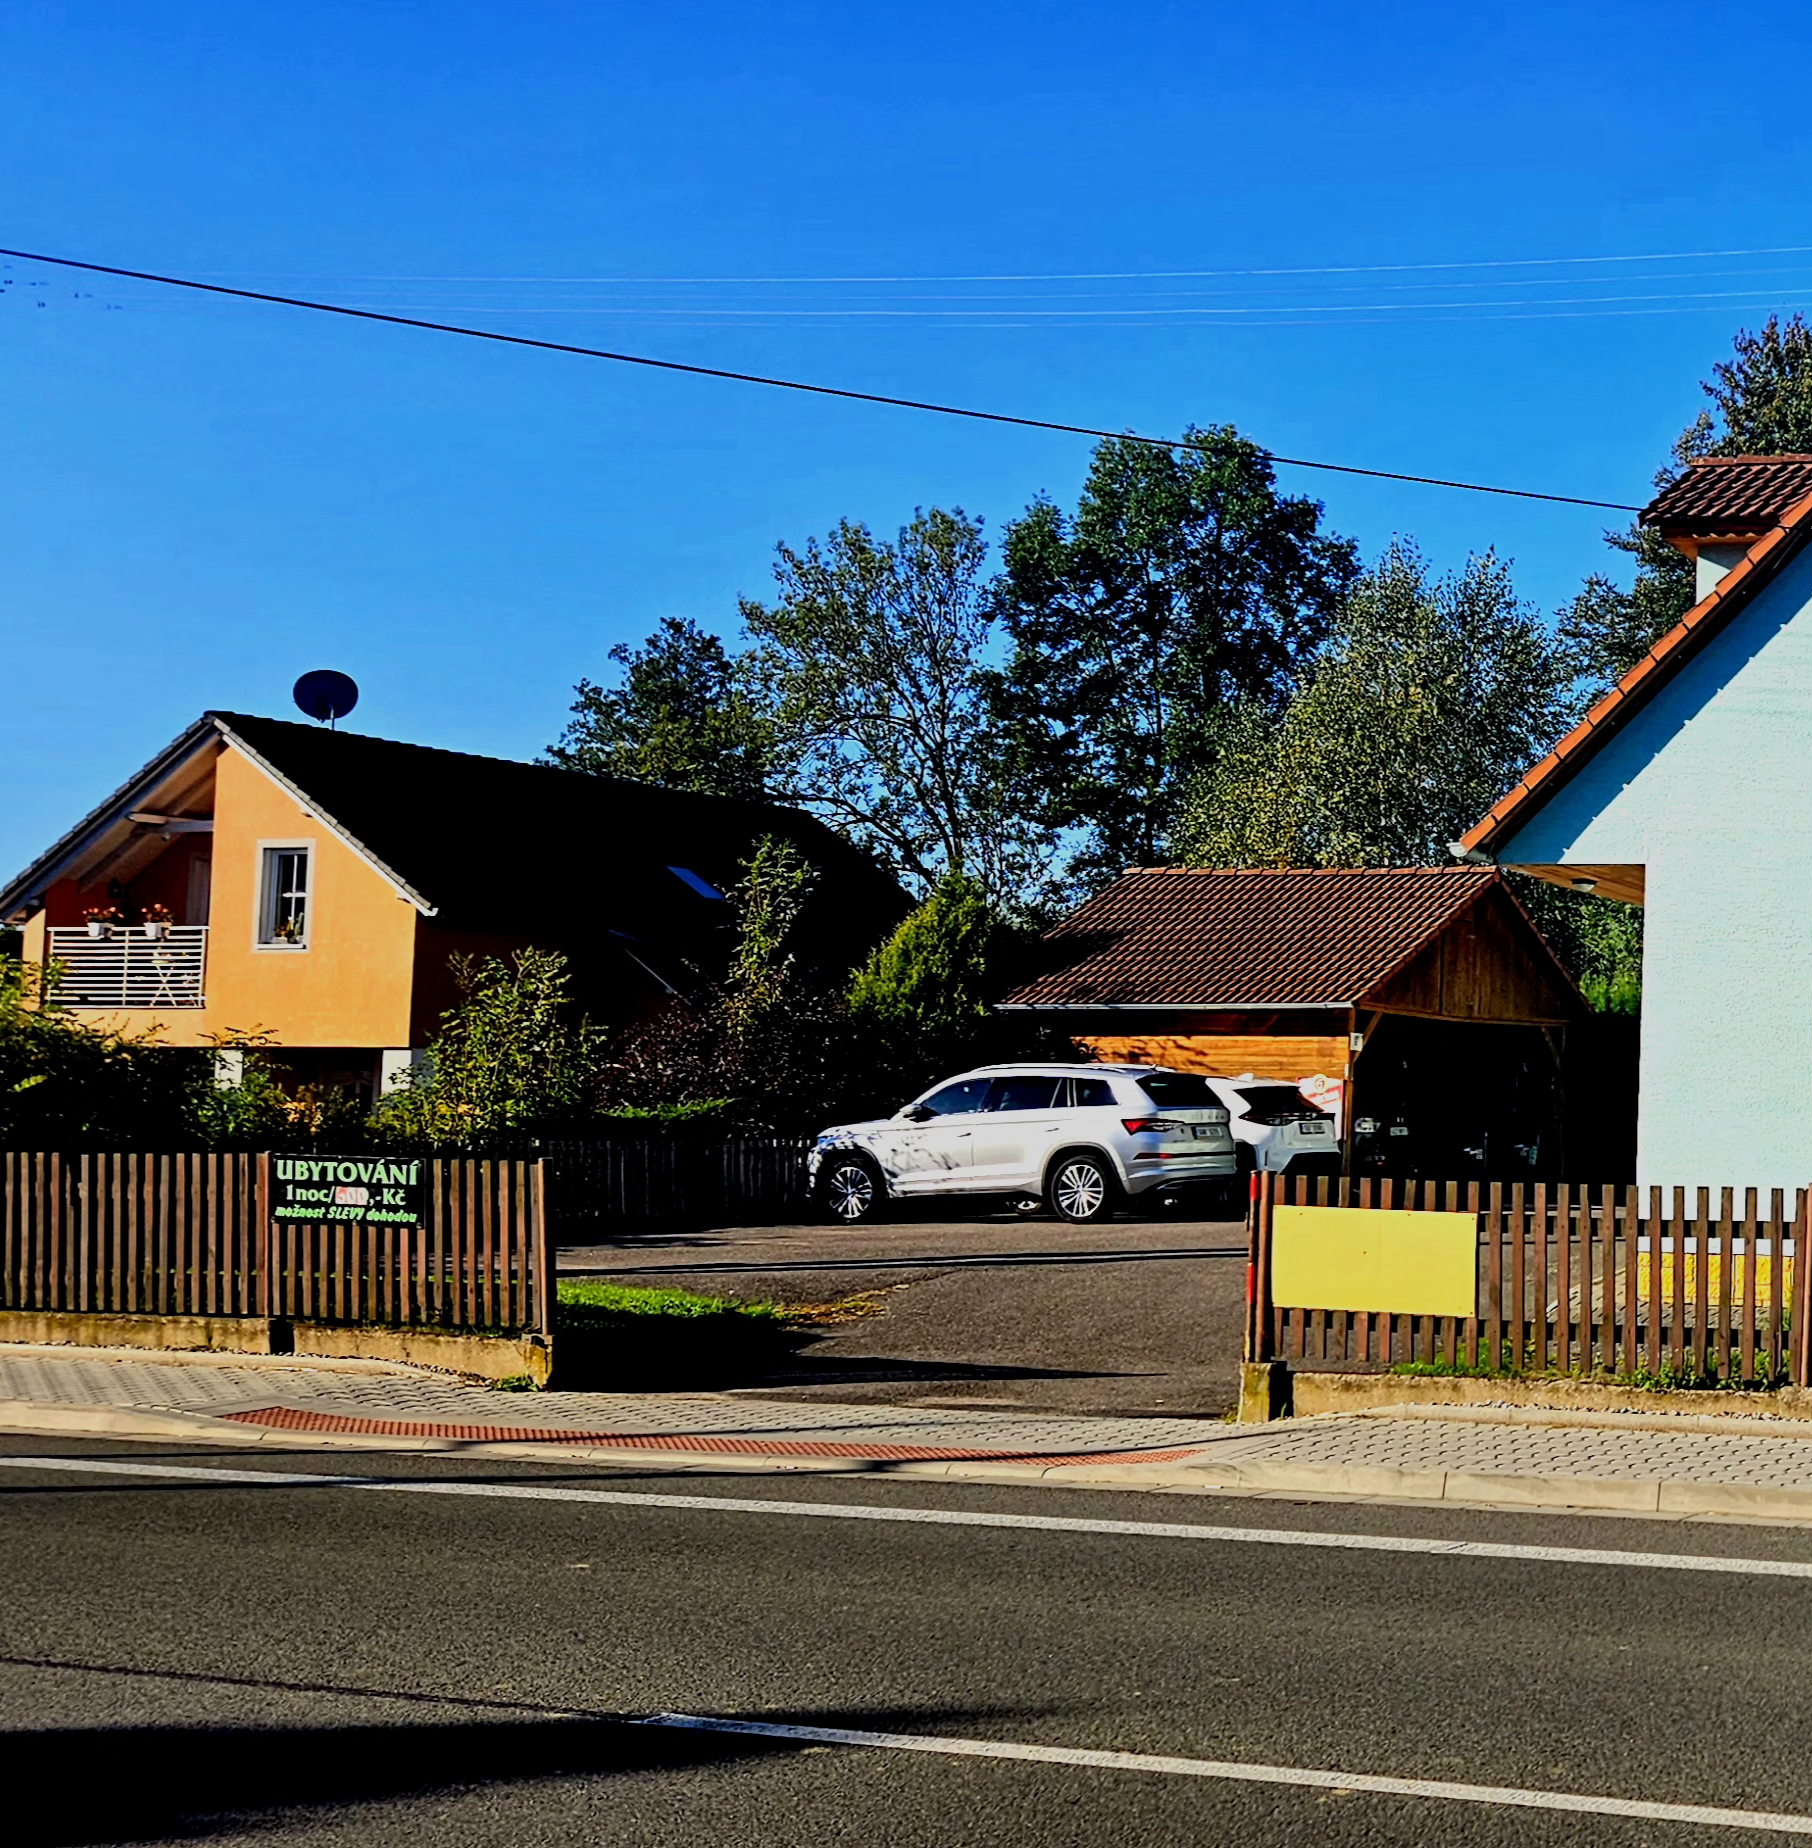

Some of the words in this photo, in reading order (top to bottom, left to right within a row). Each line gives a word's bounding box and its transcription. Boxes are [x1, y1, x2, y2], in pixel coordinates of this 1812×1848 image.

[276, 1158, 421, 1186] UBYTOVÁNÍ
[275, 1204, 326, 1219] možnost
[326, 1206, 366, 1220] SLEVY
[366, 1208, 417, 1223] dohodou
